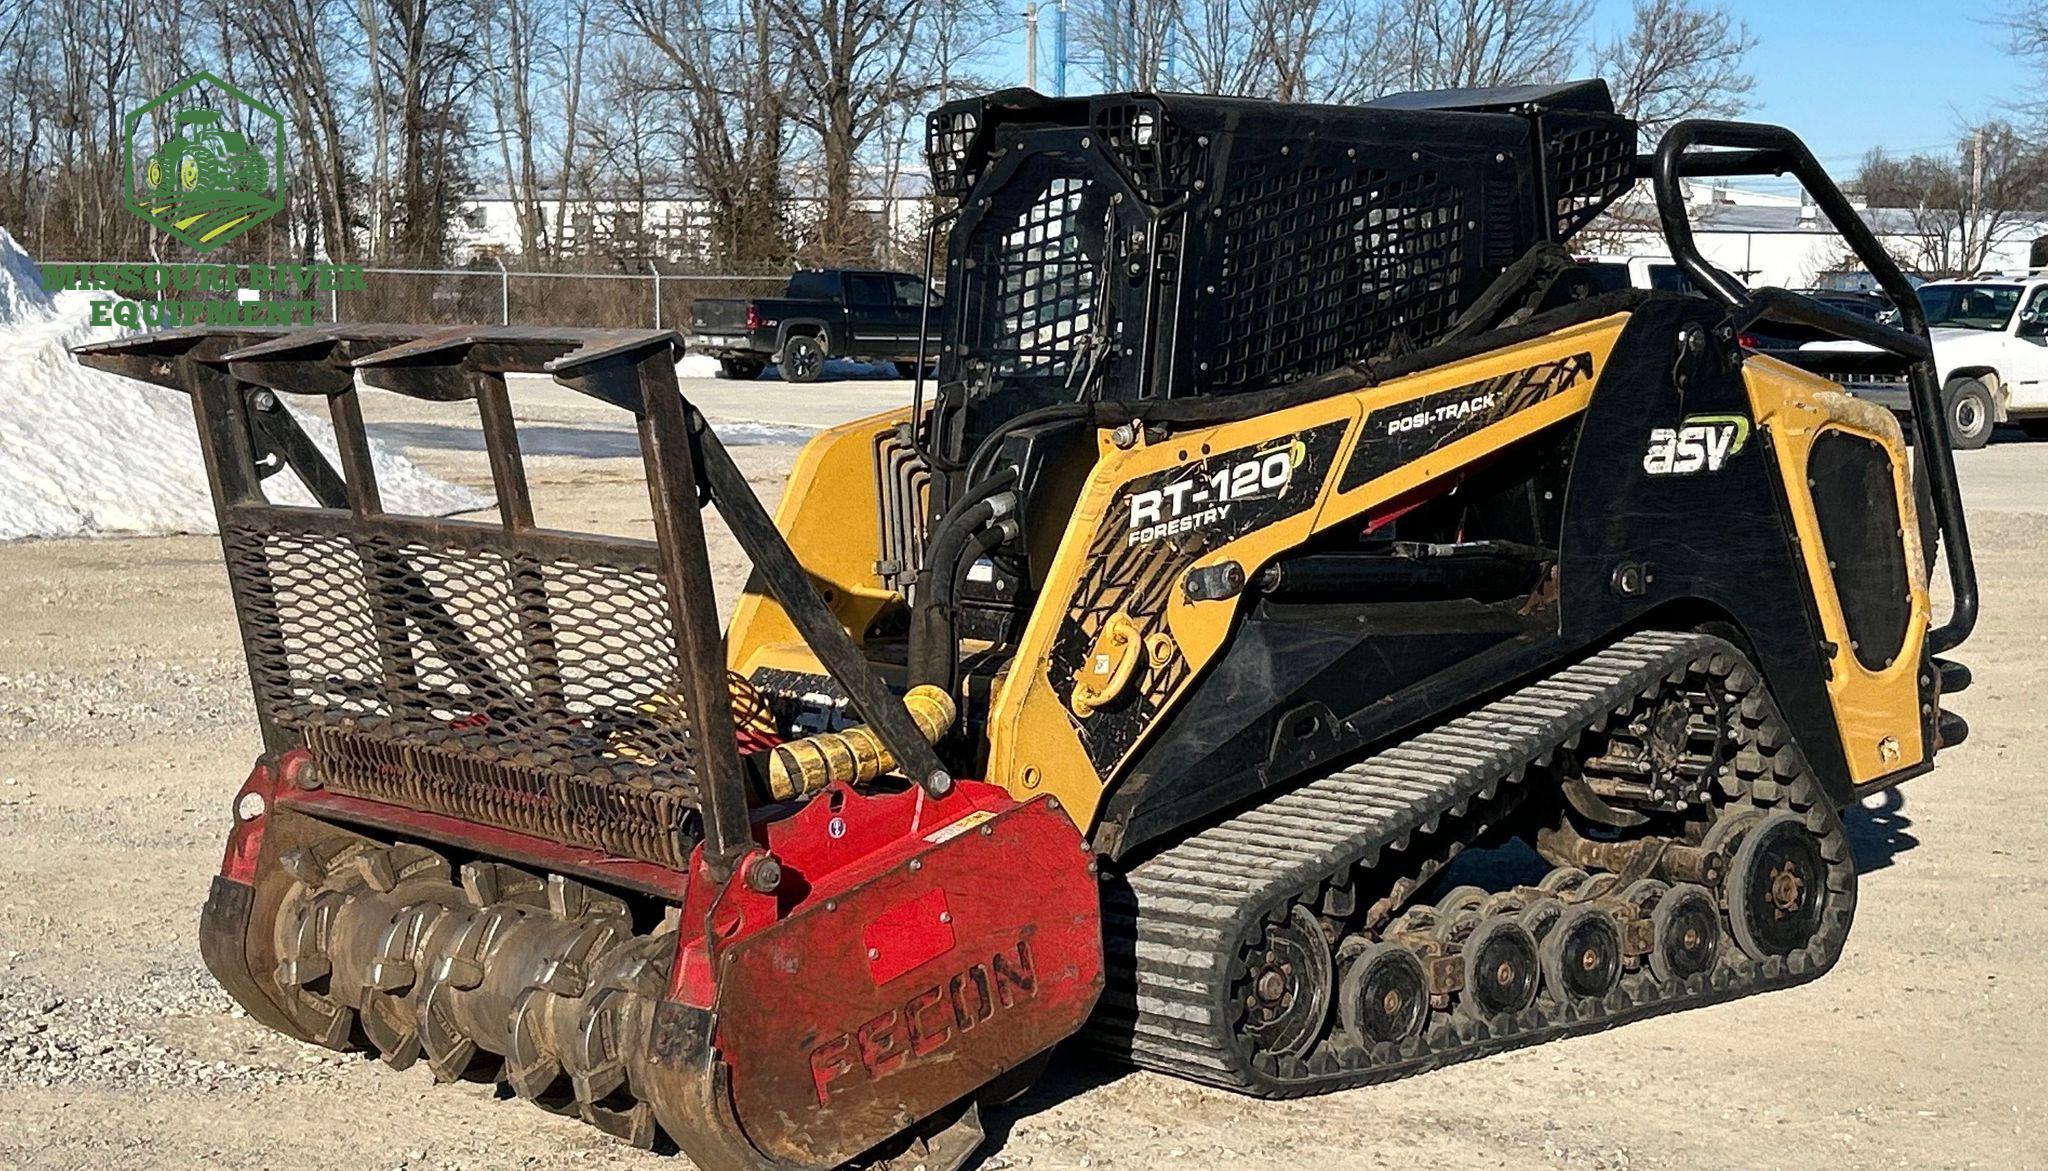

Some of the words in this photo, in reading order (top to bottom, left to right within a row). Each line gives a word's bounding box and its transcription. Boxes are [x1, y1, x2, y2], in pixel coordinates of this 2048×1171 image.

[1387, 393, 1496, 436] POSI-TRACK
[1129, 452, 1292, 529] RT-120
[1128, 503, 1231, 547] FORESTRY
[809, 940, 1038, 1109] FECON
